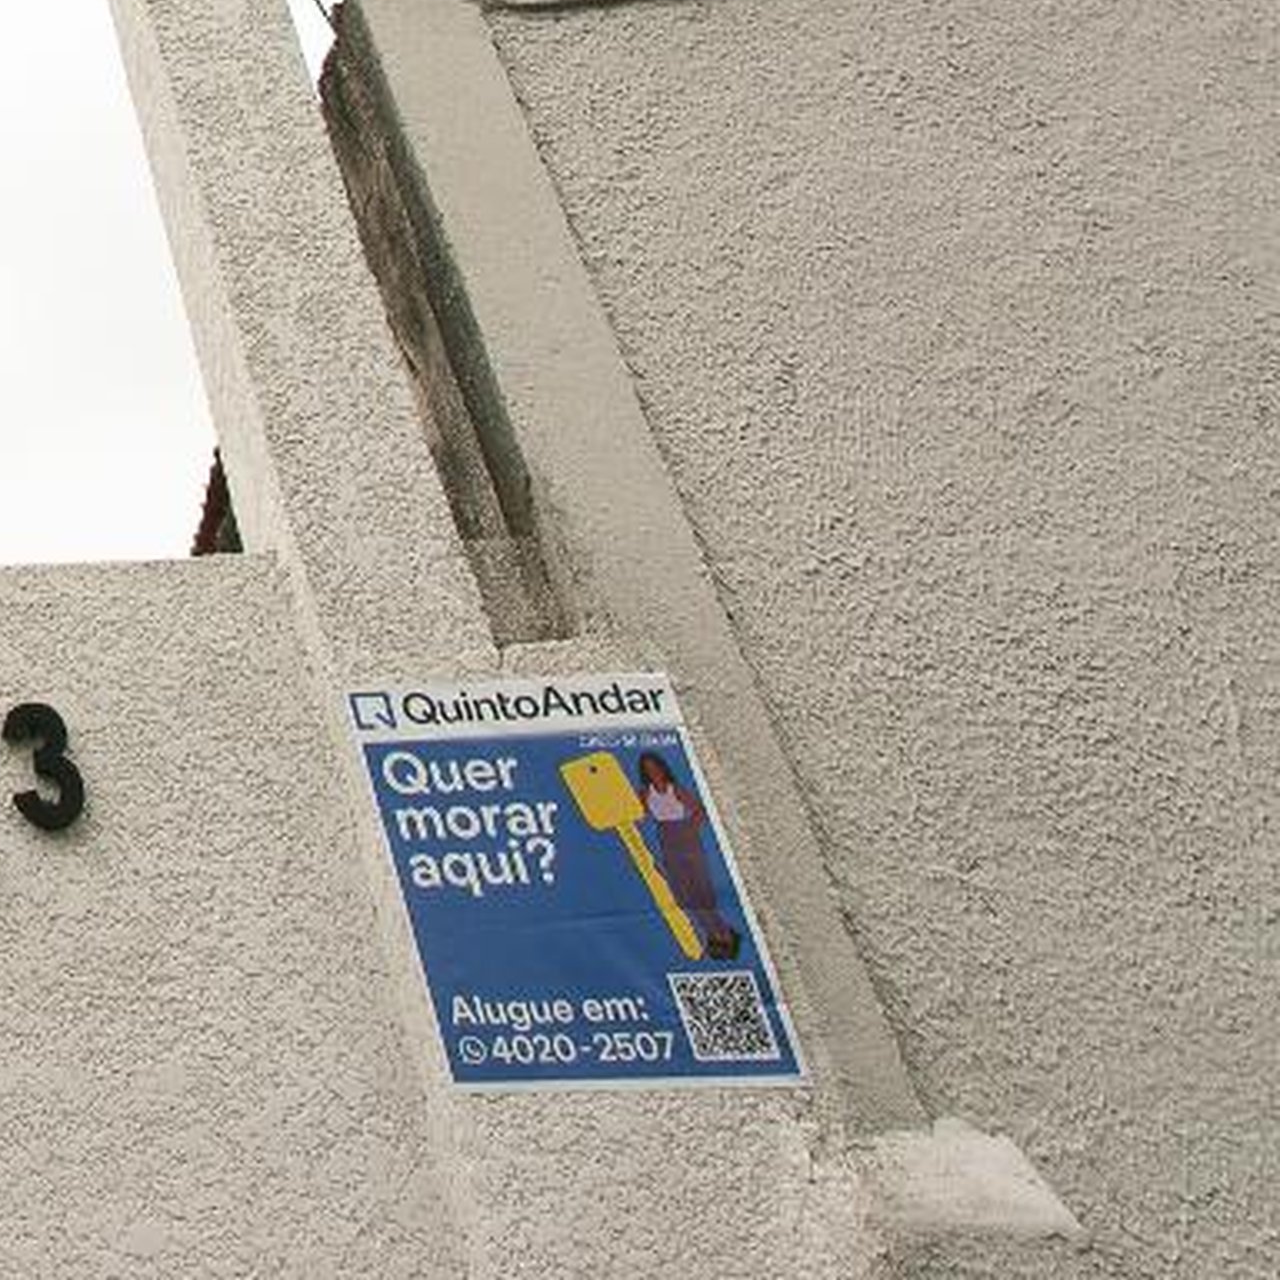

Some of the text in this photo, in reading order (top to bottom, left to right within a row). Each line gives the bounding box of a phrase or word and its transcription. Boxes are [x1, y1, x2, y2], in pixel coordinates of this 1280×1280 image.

[402, 682, 665, 726] QuintoAndar
[381, 751, 519, 795] Quer
[394, 801, 559, 842] morar
[408, 835, 557, 898] aqui?
[451, 994, 650, 1032] Alugue em:
[491, 1031, 675, 1065] 4020-2507
